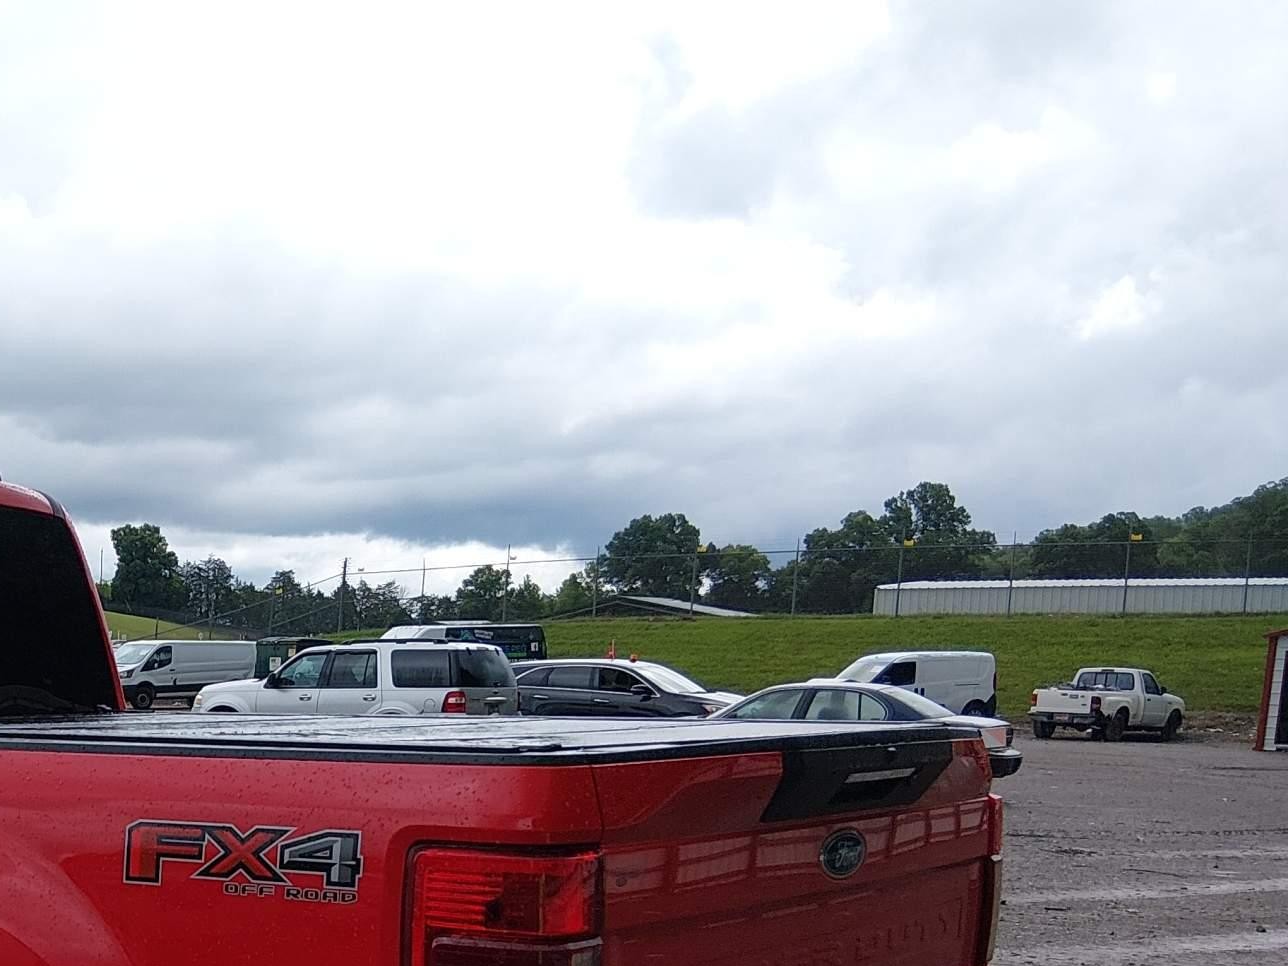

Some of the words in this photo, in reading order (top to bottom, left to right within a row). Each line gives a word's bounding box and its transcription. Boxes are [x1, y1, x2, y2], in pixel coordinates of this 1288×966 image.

[123, 818, 363, 891] FX4
[223, 882, 276, 897] OFF
[284, 886, 359, 904] ROAD
